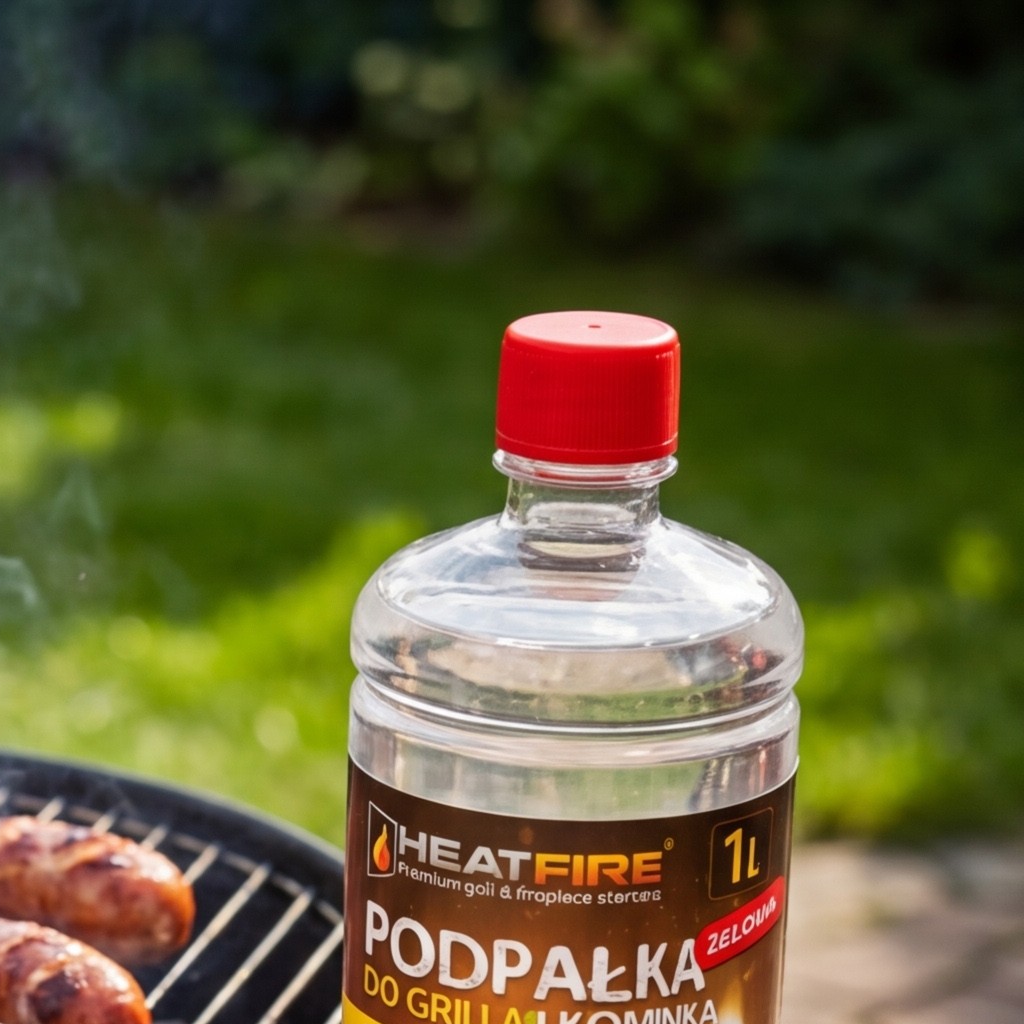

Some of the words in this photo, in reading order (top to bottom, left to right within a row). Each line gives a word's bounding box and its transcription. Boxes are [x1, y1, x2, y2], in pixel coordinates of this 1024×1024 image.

[398, 825, 663, 886] HEATFIRE
[364, 899, 706, 1003] PODPAŁKA
[363, 963, 400, 1008] DO
